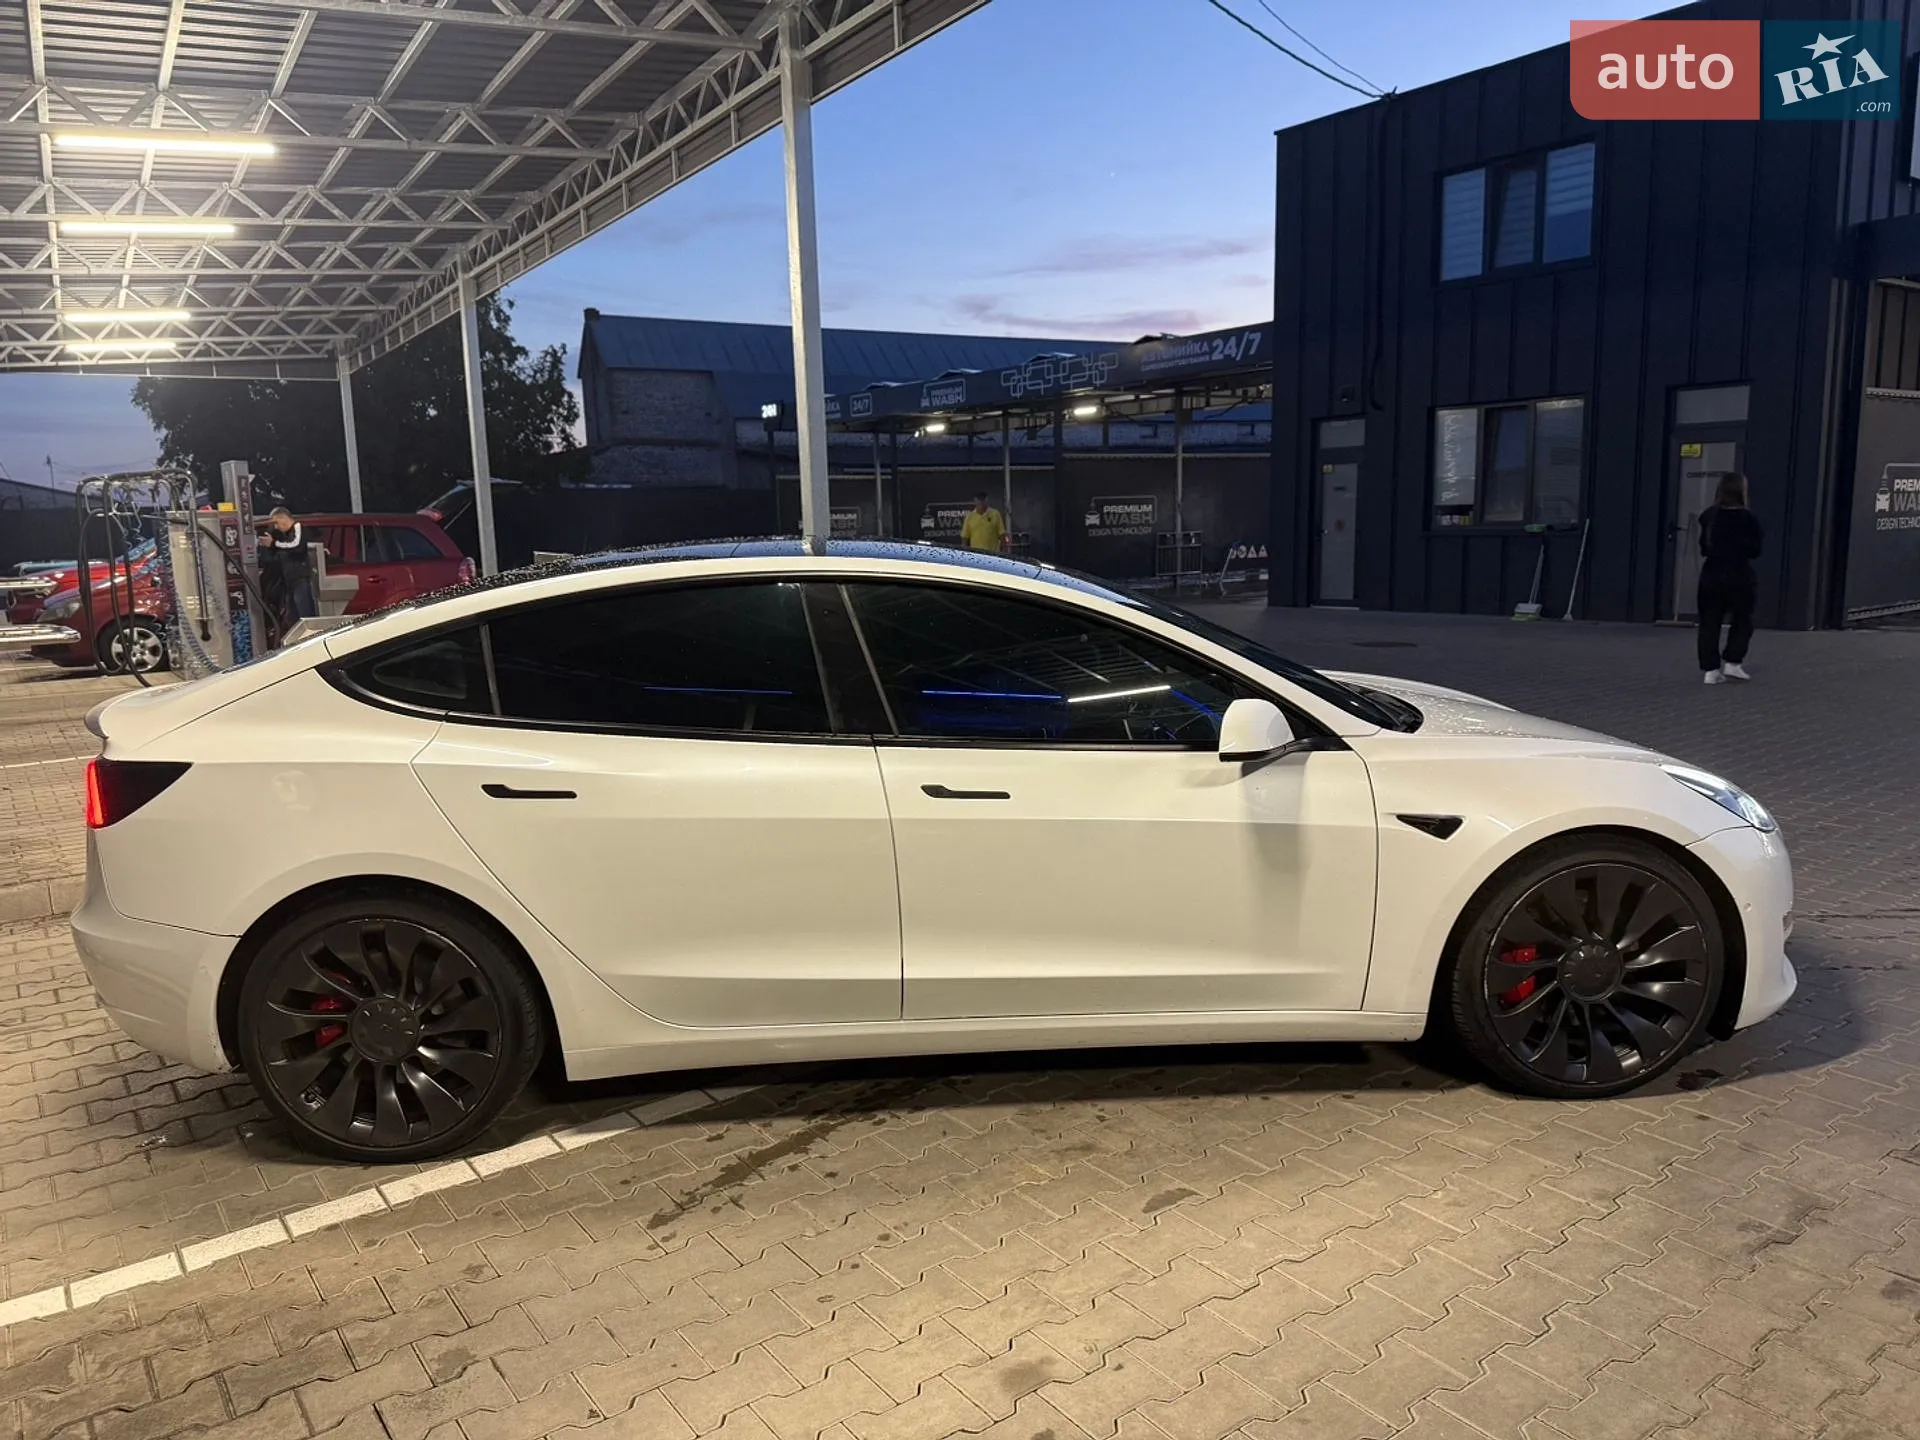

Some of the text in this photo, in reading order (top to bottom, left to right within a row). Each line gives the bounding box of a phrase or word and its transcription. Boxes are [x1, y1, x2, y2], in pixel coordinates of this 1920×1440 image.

[1211, 331, 1262, 361] 24/7
[931, 393, 963, 406] WASH
[1893, 479, 1920, 492] PREM
[1893, 492, 1920, 512] WA
[1103, 504, 1153, 513] PREMIUM
[831, 519, 858, 529] ASH
[938, 518, 962, 528] WA
[1103, 513, 1152, 525] WASH
